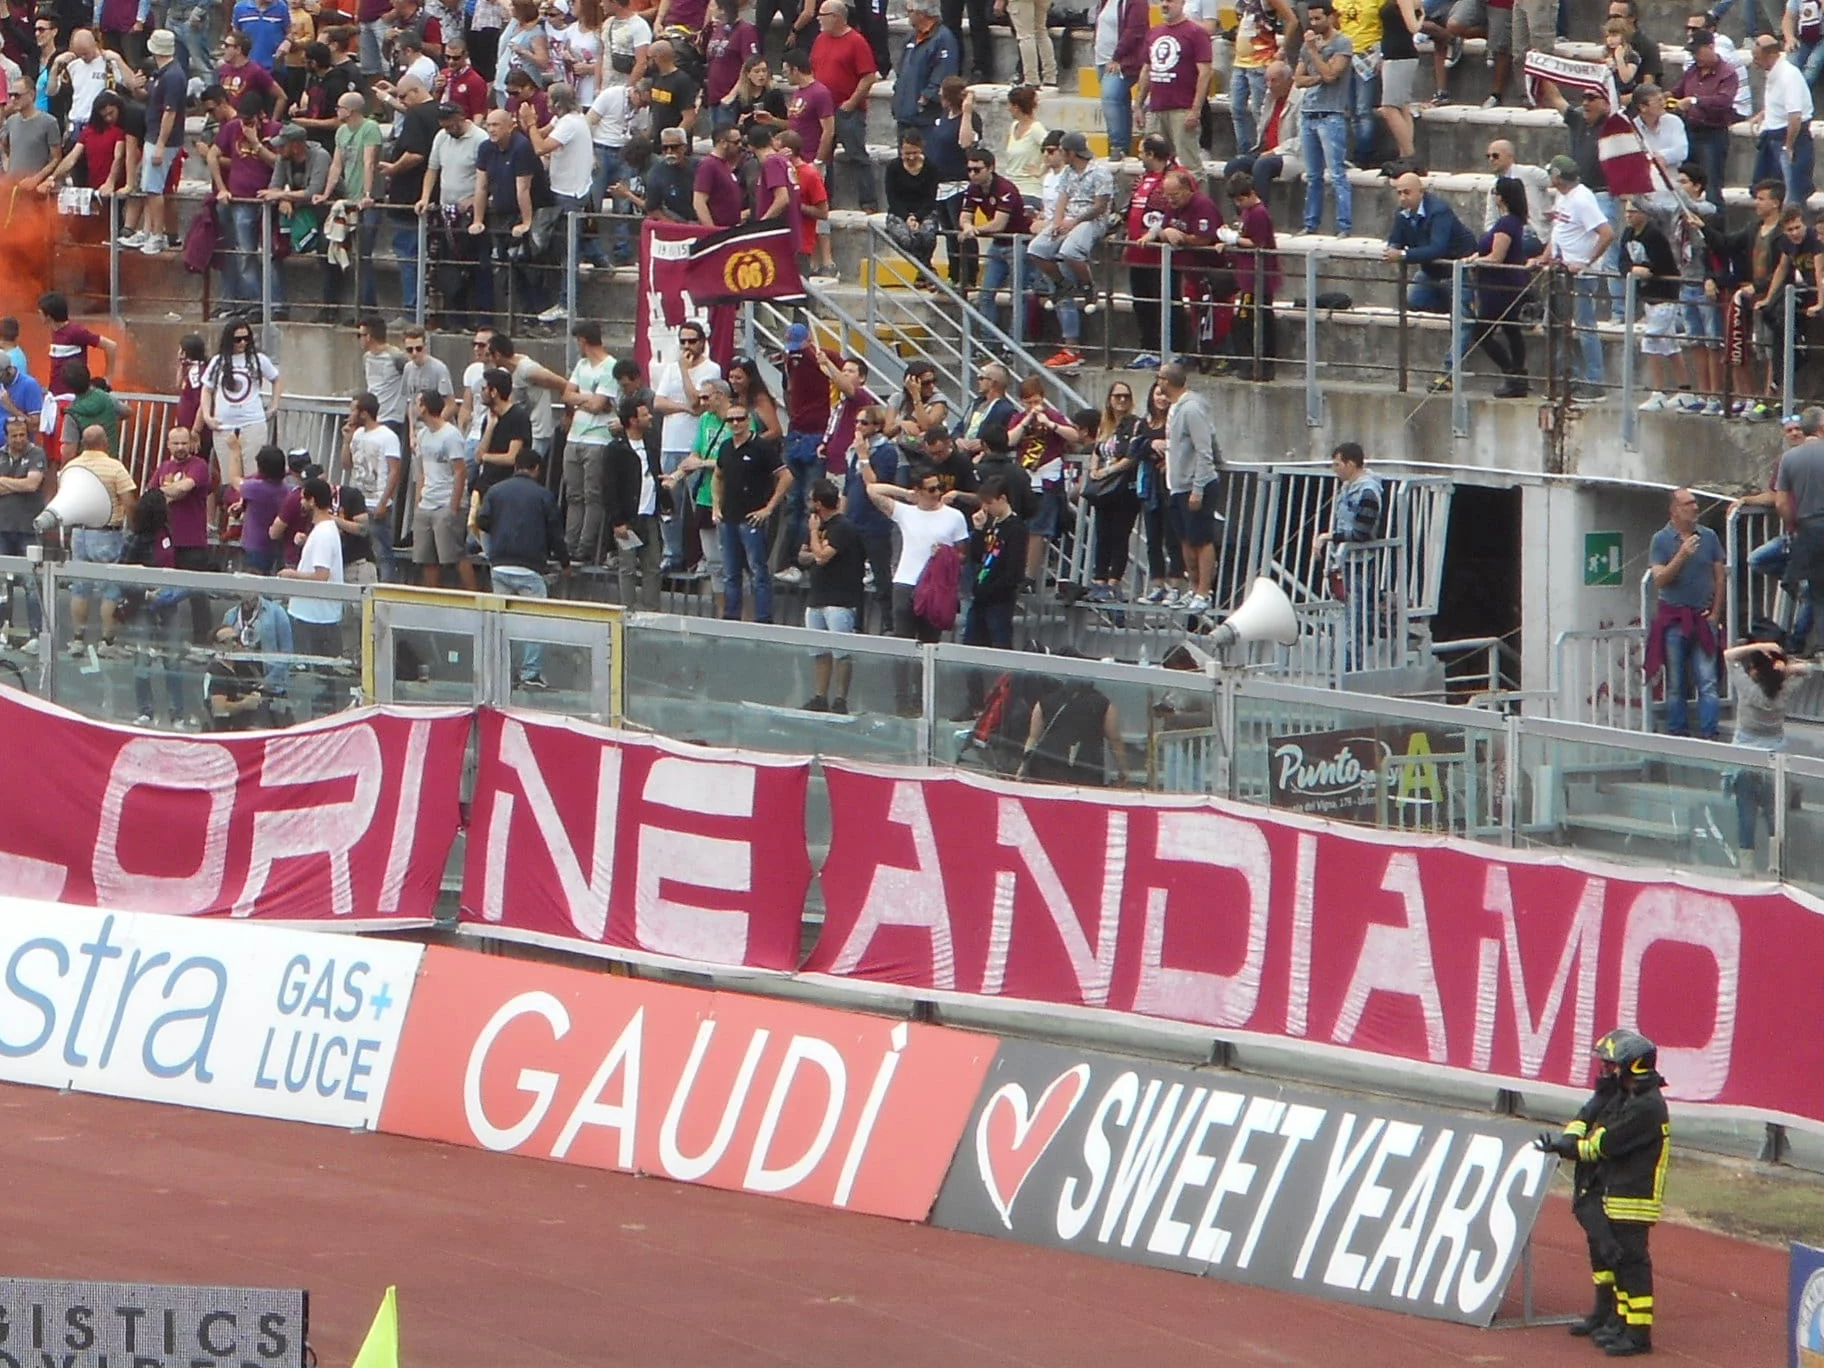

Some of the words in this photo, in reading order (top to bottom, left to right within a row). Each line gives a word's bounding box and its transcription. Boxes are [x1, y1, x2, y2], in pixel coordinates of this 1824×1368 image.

[1275, 743, 1361, 790] Punto
[481, 716, 755, 968] NE
[828, 781, 1740, 1103] ANDIAMO
[254, 1028, 381, 1102] LUCE
[1056, 1068, 1329, 1266] SWEET
[1292, 1114, 1544, 1316] YEARS
